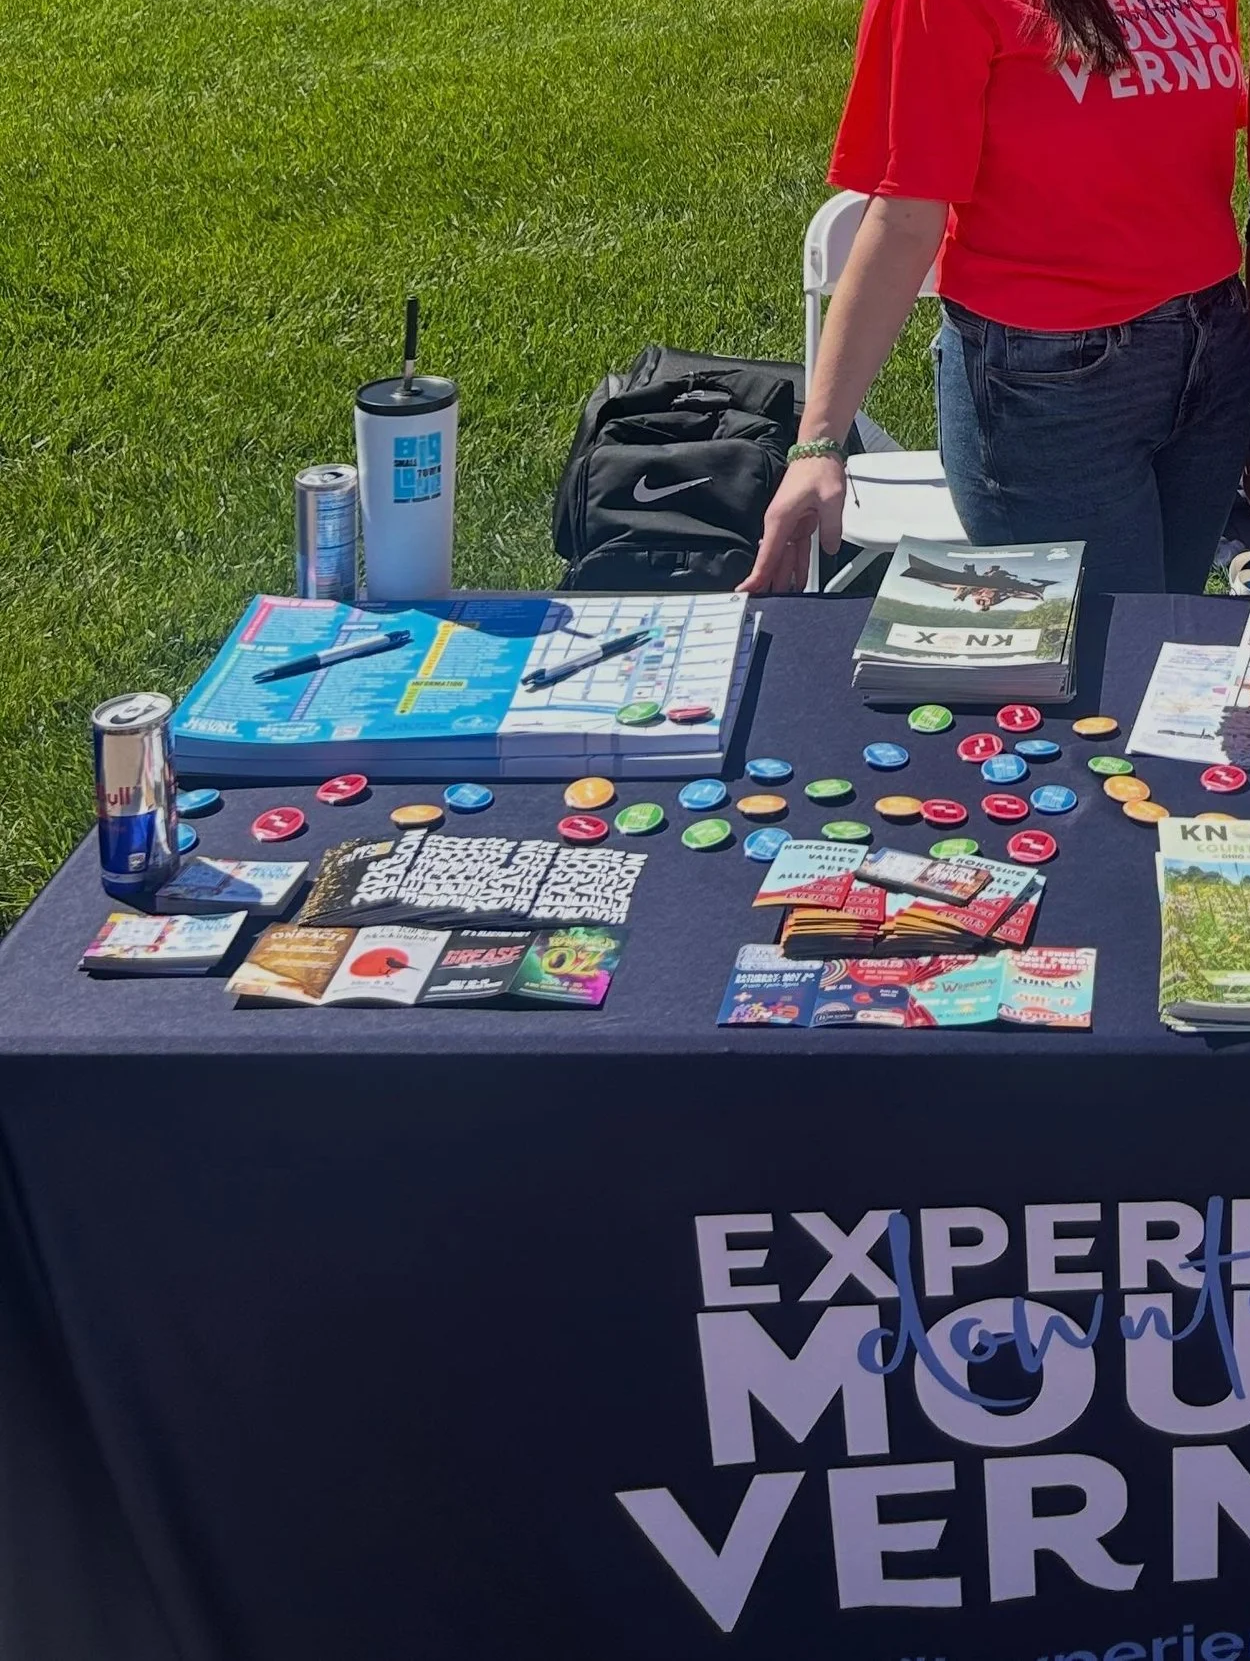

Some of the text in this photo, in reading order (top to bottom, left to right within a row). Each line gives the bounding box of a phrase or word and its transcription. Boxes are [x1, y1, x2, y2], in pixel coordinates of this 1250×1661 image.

[1121, 6, 1232, 50] OUNT
[411, 680, 464, 688] INFORMATION
[371, 827, 428, 902] SEASON
[784, 844, 859, 853] KOKOSING
[808, 854, 856, 863] VALLEY
[350, 859, 392, 908] 2026
[483, 839, 543, 911] SEASON
[608, 853, 649, 925] SEASON
[441, 945, 526, 966] GREASE
[540, 945, 606, 978] OZ
[858, 959, 904, 969] CIRCLES
